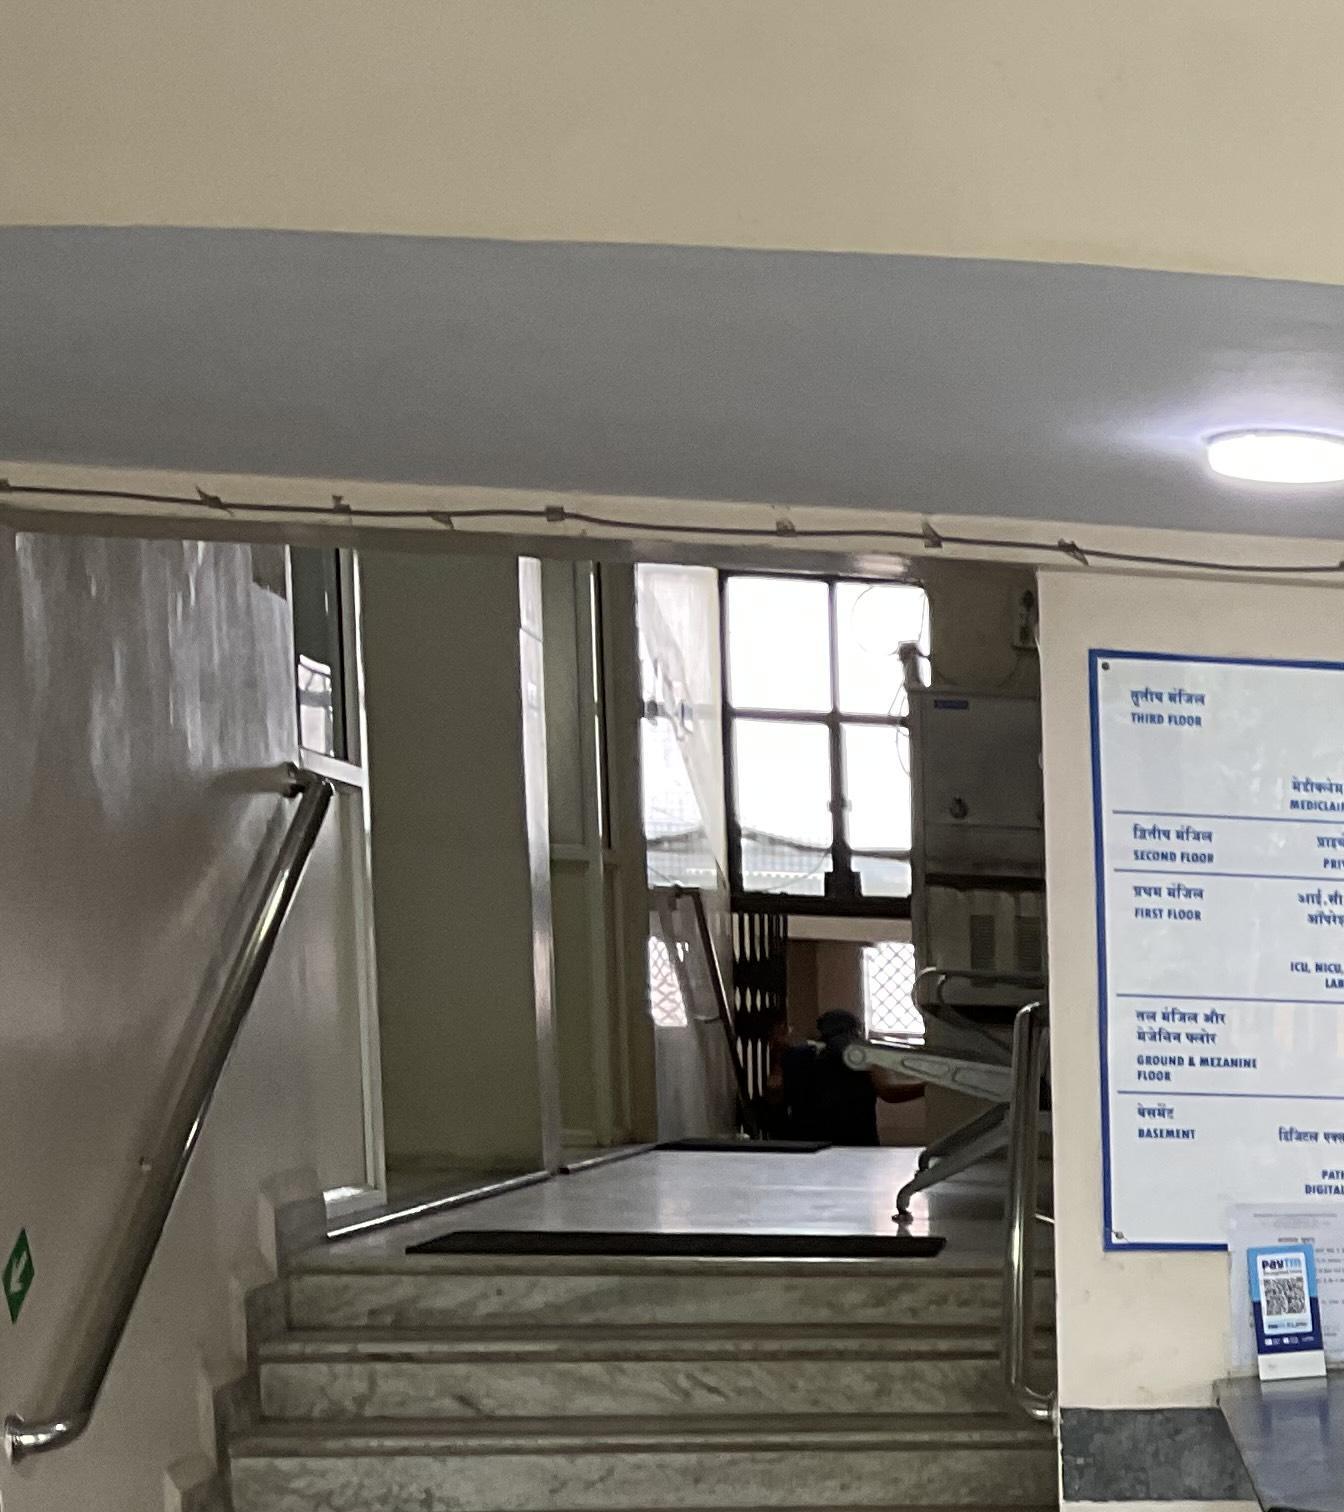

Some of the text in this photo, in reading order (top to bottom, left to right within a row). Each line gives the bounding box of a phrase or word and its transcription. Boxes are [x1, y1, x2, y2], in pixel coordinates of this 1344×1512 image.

[1131, 712, 1201, 726] THIRD FLOOR
[1134, 850, 1213, 863] SECOND FLOOR
[1135, 908, 1201, 920] FIRST FLOOR
[1291, 962, 1310, 973] ICU,
[1315, 962, 1343, 974] NICU,
[1136, 1008, 1225, 1024] तल मंजिल और
[1137, 1055, 1256, 1068] GROUND & MEZANINE
[1138, 1070, 1170, 1081] FLOOR
[1138, 1129, 1194, 1139] BASEMENT
[1305, 1184, 1344, 1195] DIGITAL
